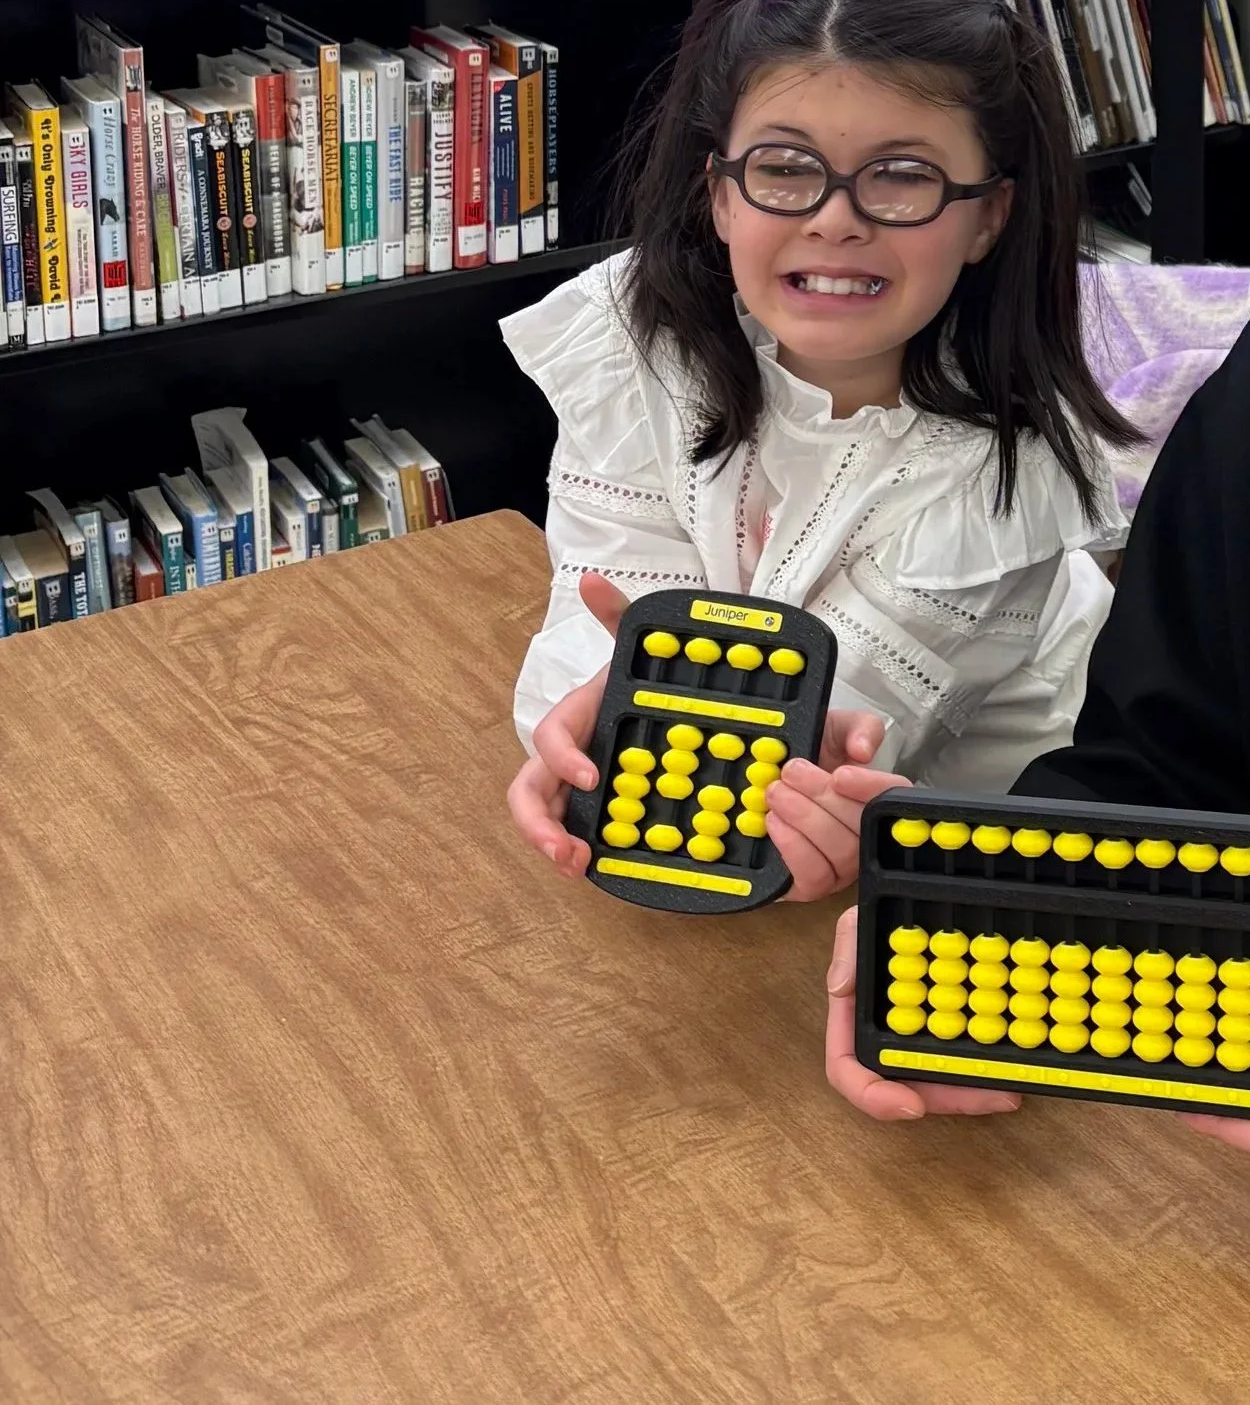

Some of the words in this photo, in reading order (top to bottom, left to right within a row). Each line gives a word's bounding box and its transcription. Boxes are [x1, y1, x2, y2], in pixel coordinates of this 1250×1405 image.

[349, 79, 358, 111] ANDREW
[304, 101, 314, 131] RACE
[349, 113, 357, 138] BEYER
[499, 94, 513, 133] ALIVE
[547, 69, 557, 174] HORSEPLAYERS
[103, 117, 117, 151] Horse
[131, 127, 141, 159] HORSE
[191, 132, 204, 157] Bradt
[324, 94, 339, 184] SECRETARIAT
[389, 125, 401, 144] THE
[41, 144, 54, 171] Only
[104, 154, 117, 187] Crazy
[173, 133, 188, 181] RIDERS
[270, 145, 280, 173] DEATH
[305, 136, 316, 174] HORSE
[349, 146, 357, 170] BEYER
[365, 145, 373, 170] BEYER
[389, 149, 401, 174] FAST
[434, 132, 453, 201] JUSTIFY
[71, 171, 88, 209] GIRLS
[133, 162, 143, 198] RIDING
[216, 151, 228, 216] SEABISCUIT
[241, 149, 253, 213] SEABISCUIT
[307, 179, 317, 203] MEN
[365, 184, 373, 209] SPEED
[389, 178, 402, 203] RIDE
[45, 176, 57, 233] Drowning
[199, 177, 209, 230] CONNEMARA
[349, 186, 358, 210] SPEED
[2, 189, 17, 242] SURFING
[136, 211, 146, 236] CARE
[273, 202, 284, 253] RACEHORSE
[180, 204, 195, 262] CERTAIN
[203, 232, 212, 270] JOURNEY
[48, 255, 60, 290] David
[73, 572, 86, 595] THE
[704, 603, 749, 622] Juniper
